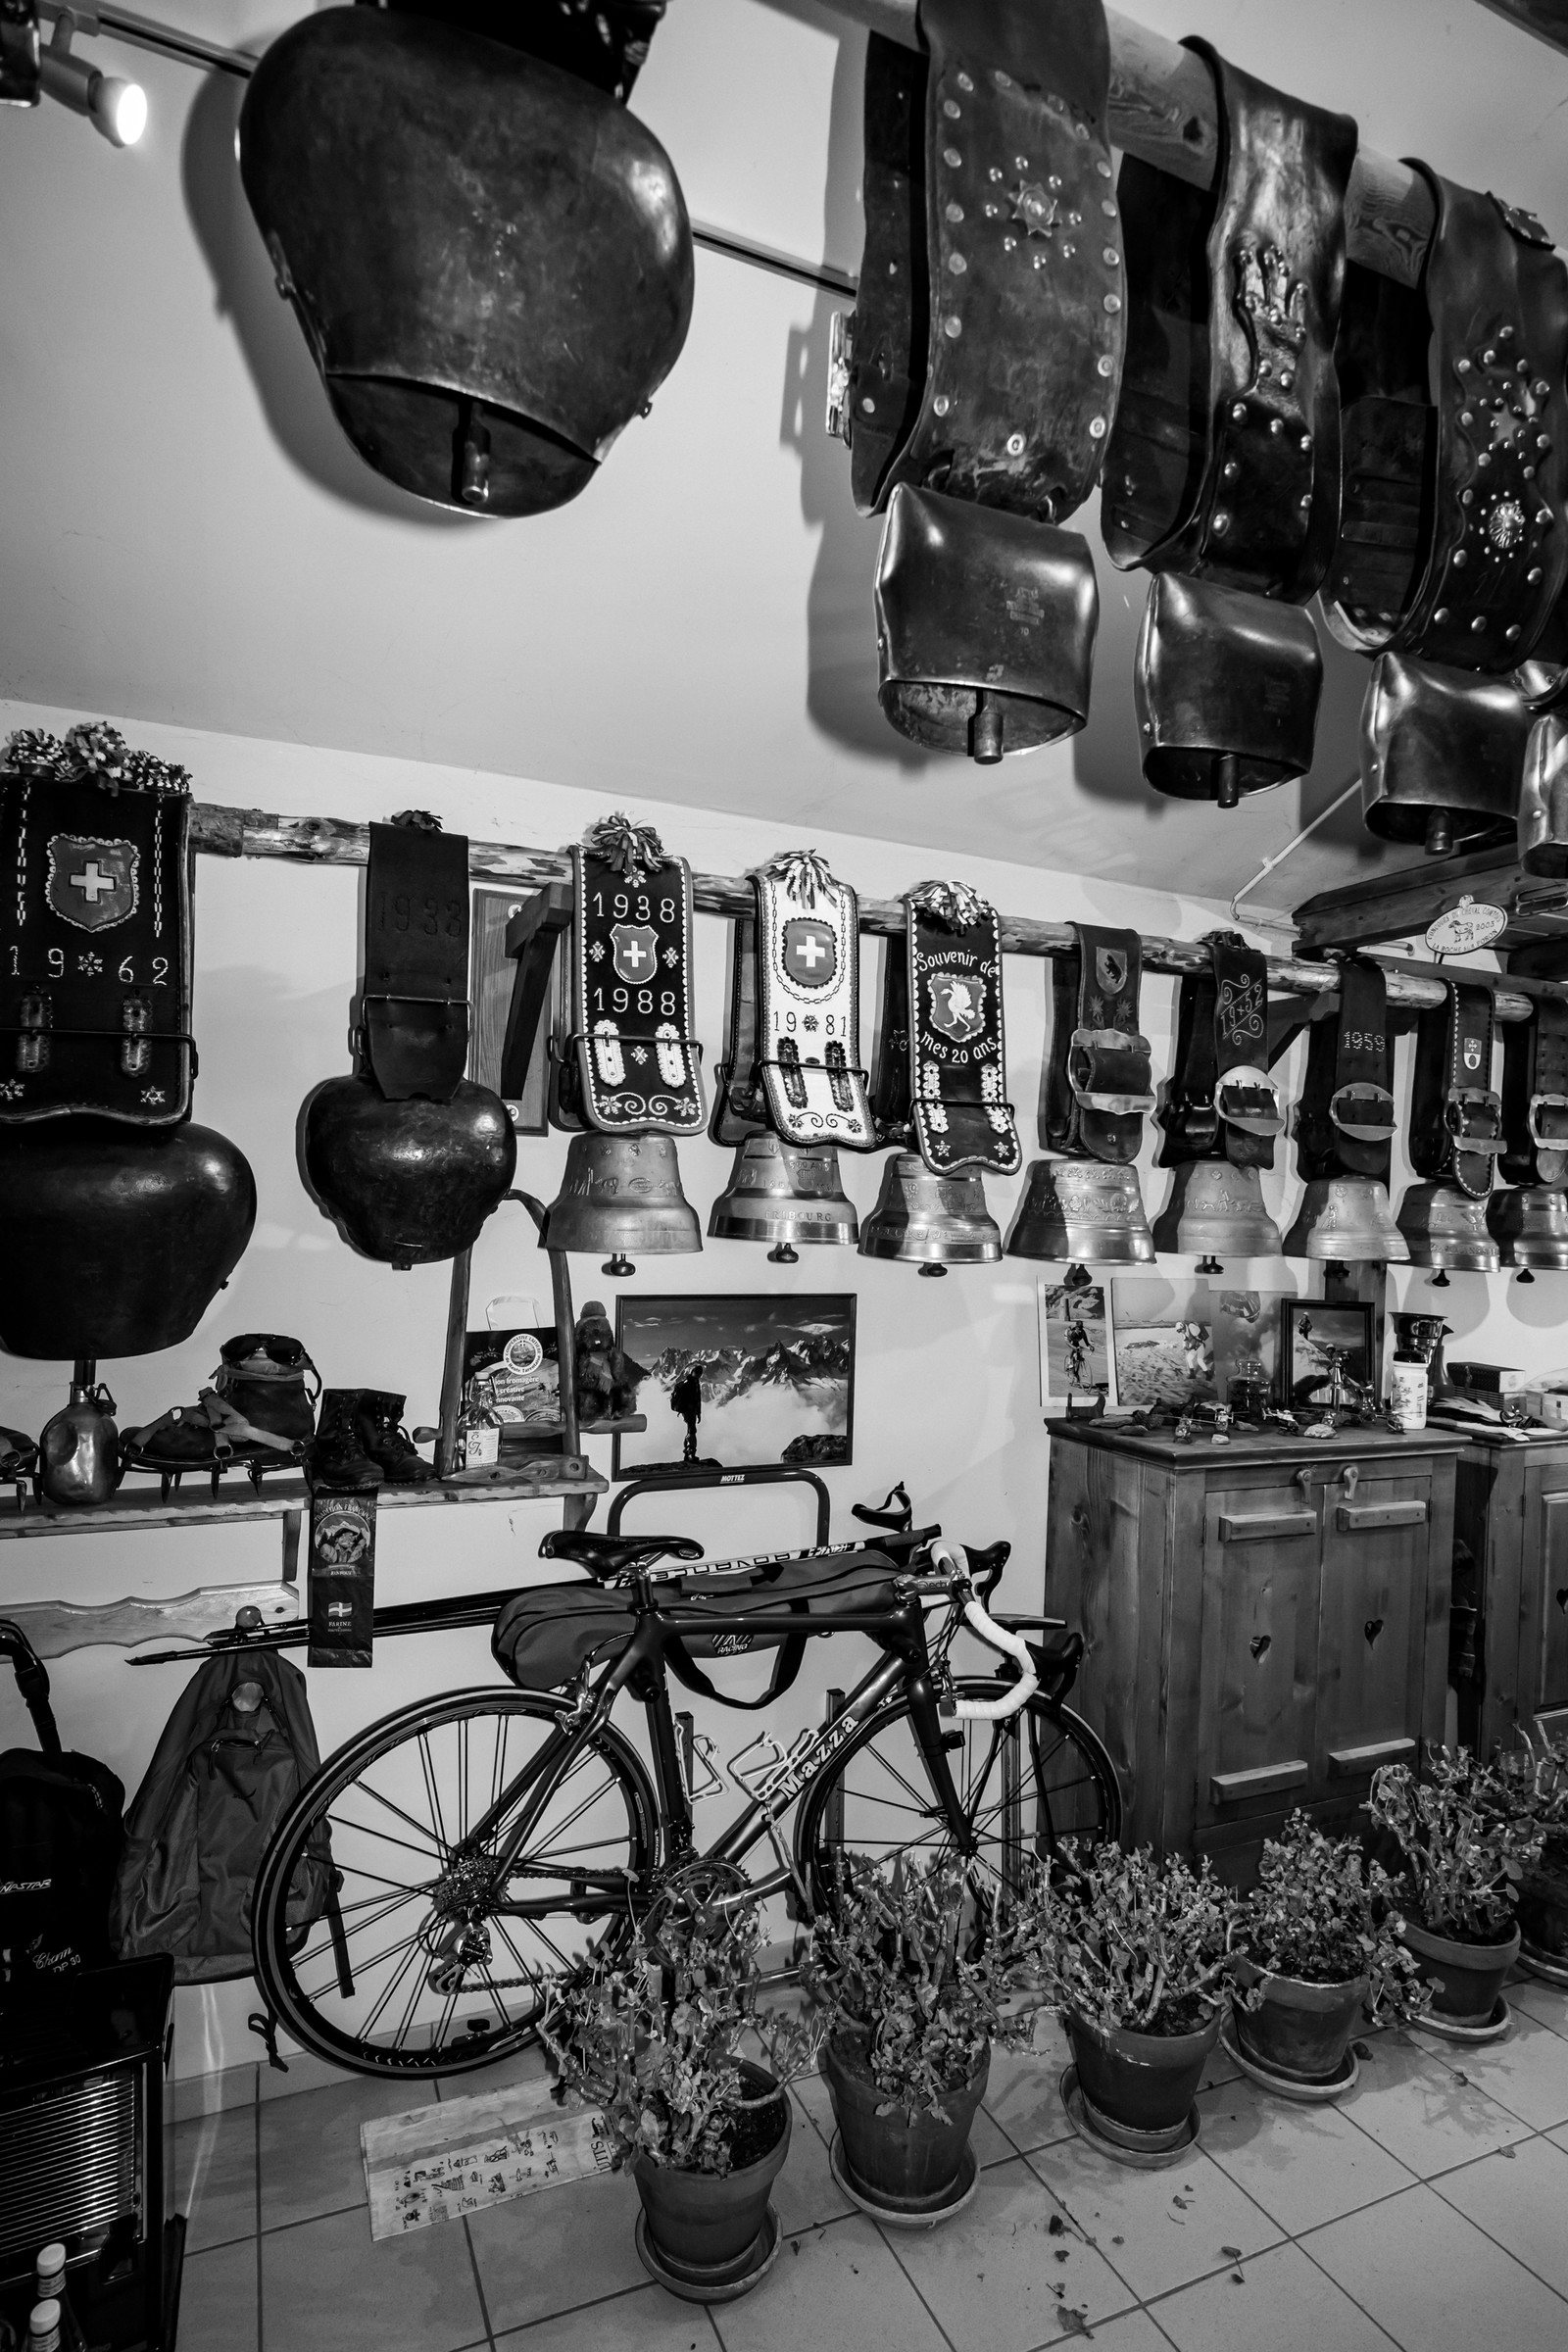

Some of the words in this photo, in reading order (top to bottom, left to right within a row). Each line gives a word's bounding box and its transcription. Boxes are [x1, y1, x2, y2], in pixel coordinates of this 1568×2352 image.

[593, 892, 675, 923] 1938
[1427, 914, 1450, 940] CONCOURS
[1461, 906, 1481, 915] CHEVAL
[1476, 929, 1498, 947] FORON
[916, 949, 978, 971] Souvenir
[980, 960, 997, 978] de
[593, 987, 676, 1016] 1988
[920, 1031, 949, 1059] mes
[952, 1049, 968, 1063] 20
[973, 1037, 997, 1059] ans
[1344, 1031, 1385, 1053] 1959
[764, 1210, 832, 1222] FRIBOURG
[495, 1395, 525, 1403] nnovante
[315, 1502, 343, 1521] TRADITION
[717, 1643, 749, 1654] RACING
[777, 1716, 859, 1800] Mazza
[0, 1879, 52, 1893] NASTAR
[70, 1954, 80, 1966] 30
